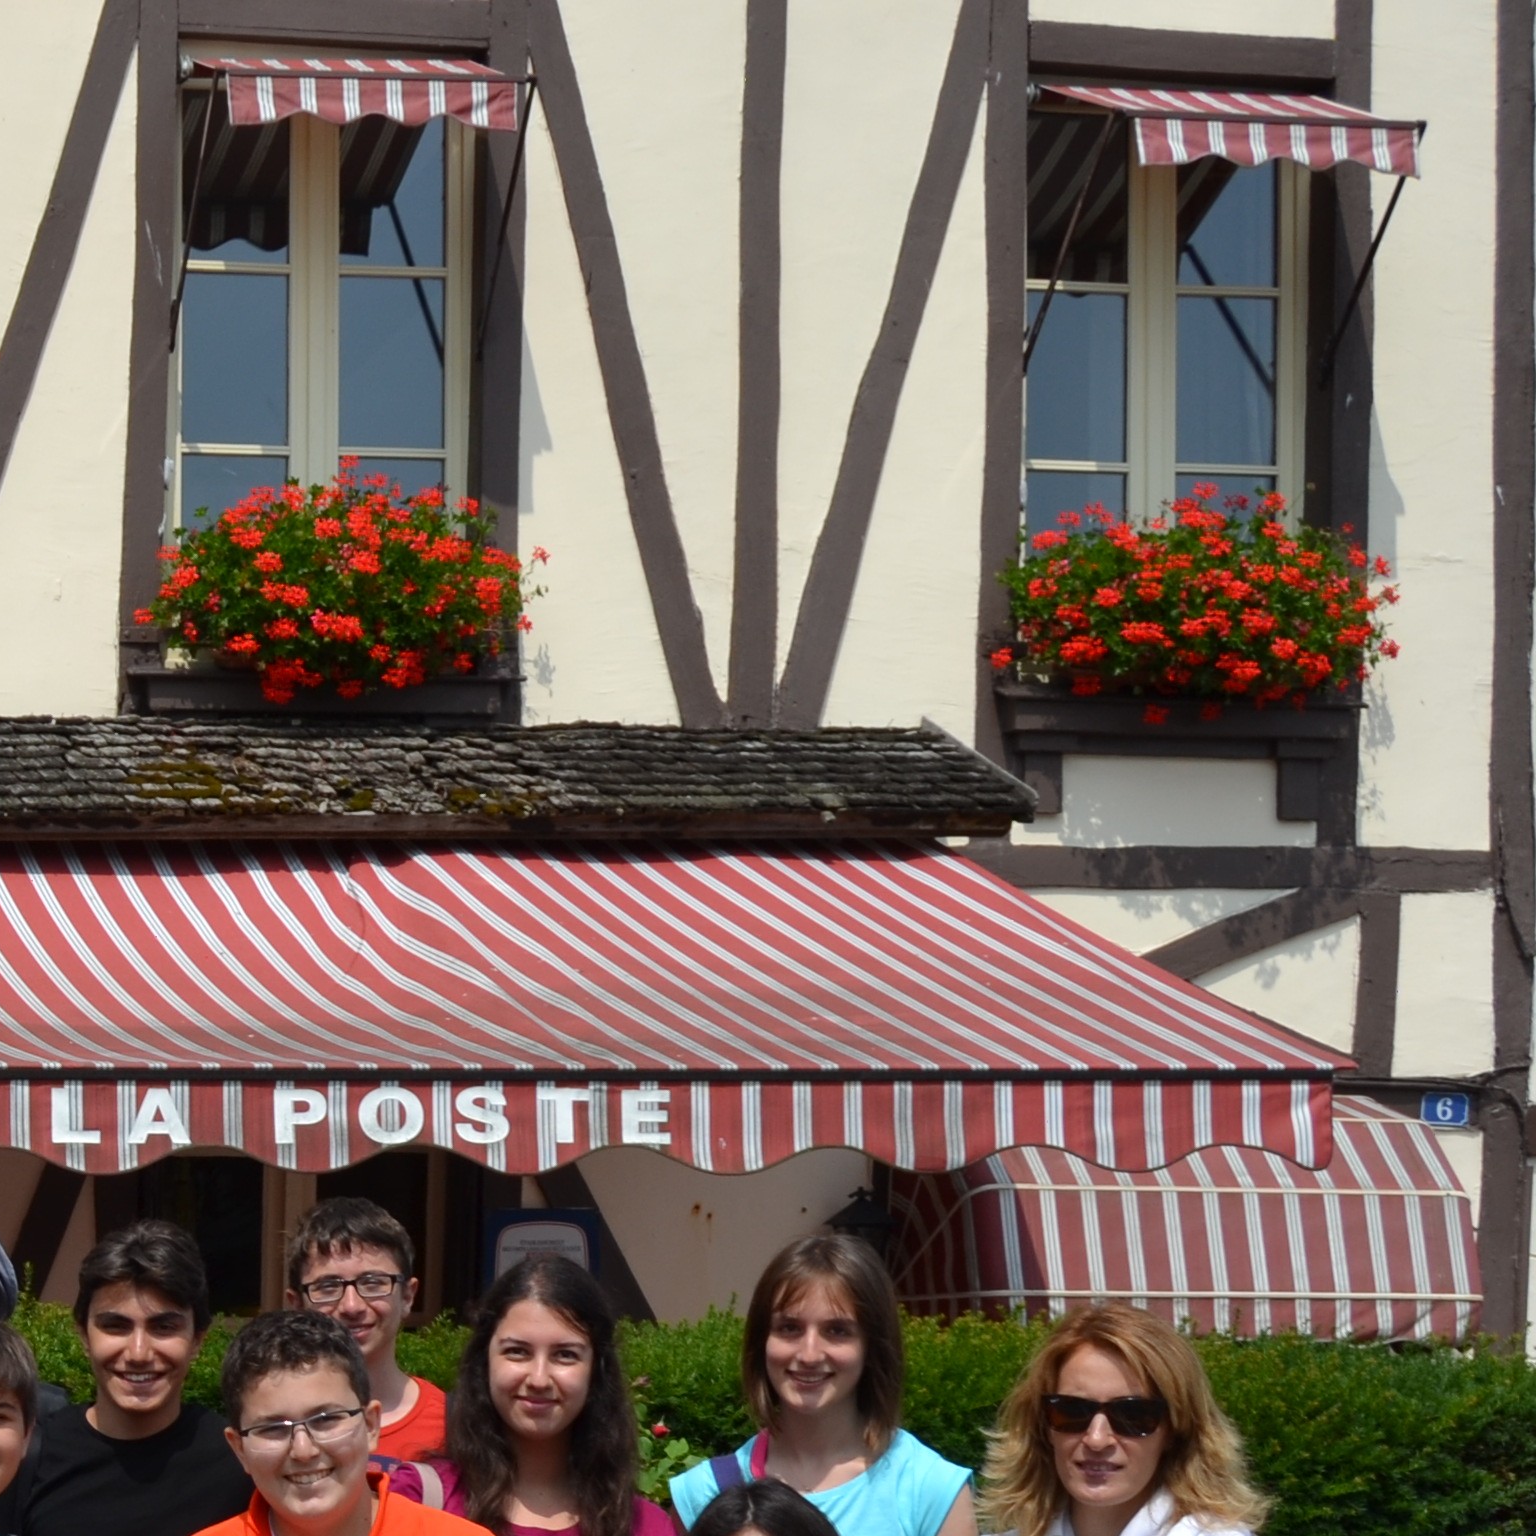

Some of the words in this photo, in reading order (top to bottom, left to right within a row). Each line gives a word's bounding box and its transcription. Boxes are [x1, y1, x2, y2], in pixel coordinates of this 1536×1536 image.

[51, 1087, 191, 1145] LA
[274, 1087, 672, 1145] POSTE
[1436, 1097, 1453, 1121] 6
